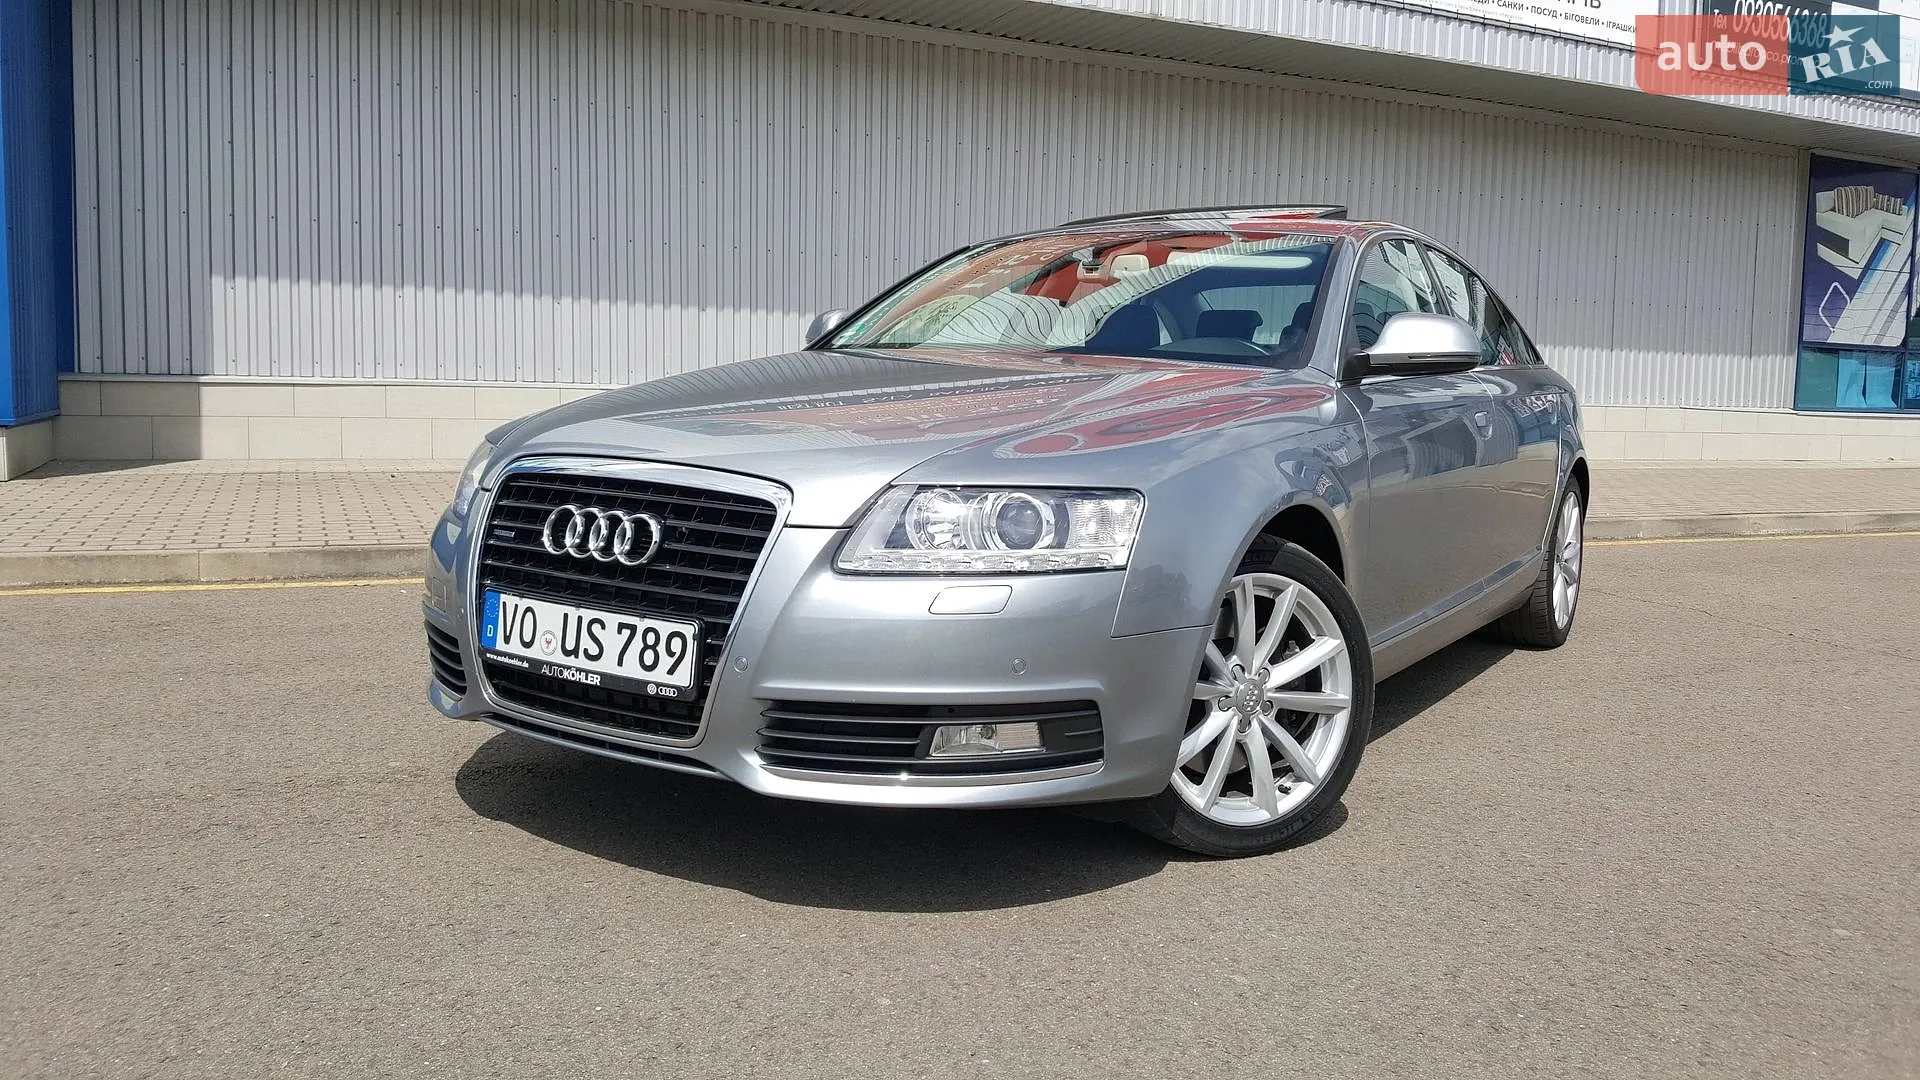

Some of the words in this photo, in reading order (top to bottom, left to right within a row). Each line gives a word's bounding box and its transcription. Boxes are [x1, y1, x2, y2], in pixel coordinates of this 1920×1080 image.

[1530, 5, 1558, 19] ПОСУД
[1564, 12, 1600, 27] БІГОВЕЛИ
[1733, 0, 1828, 49] 0930566368
[486, 624, 493, 637] D
[502, 601, 538, 649] VO
[560, 612, 606, 662] US
[616, 621, 688, 676] 789
